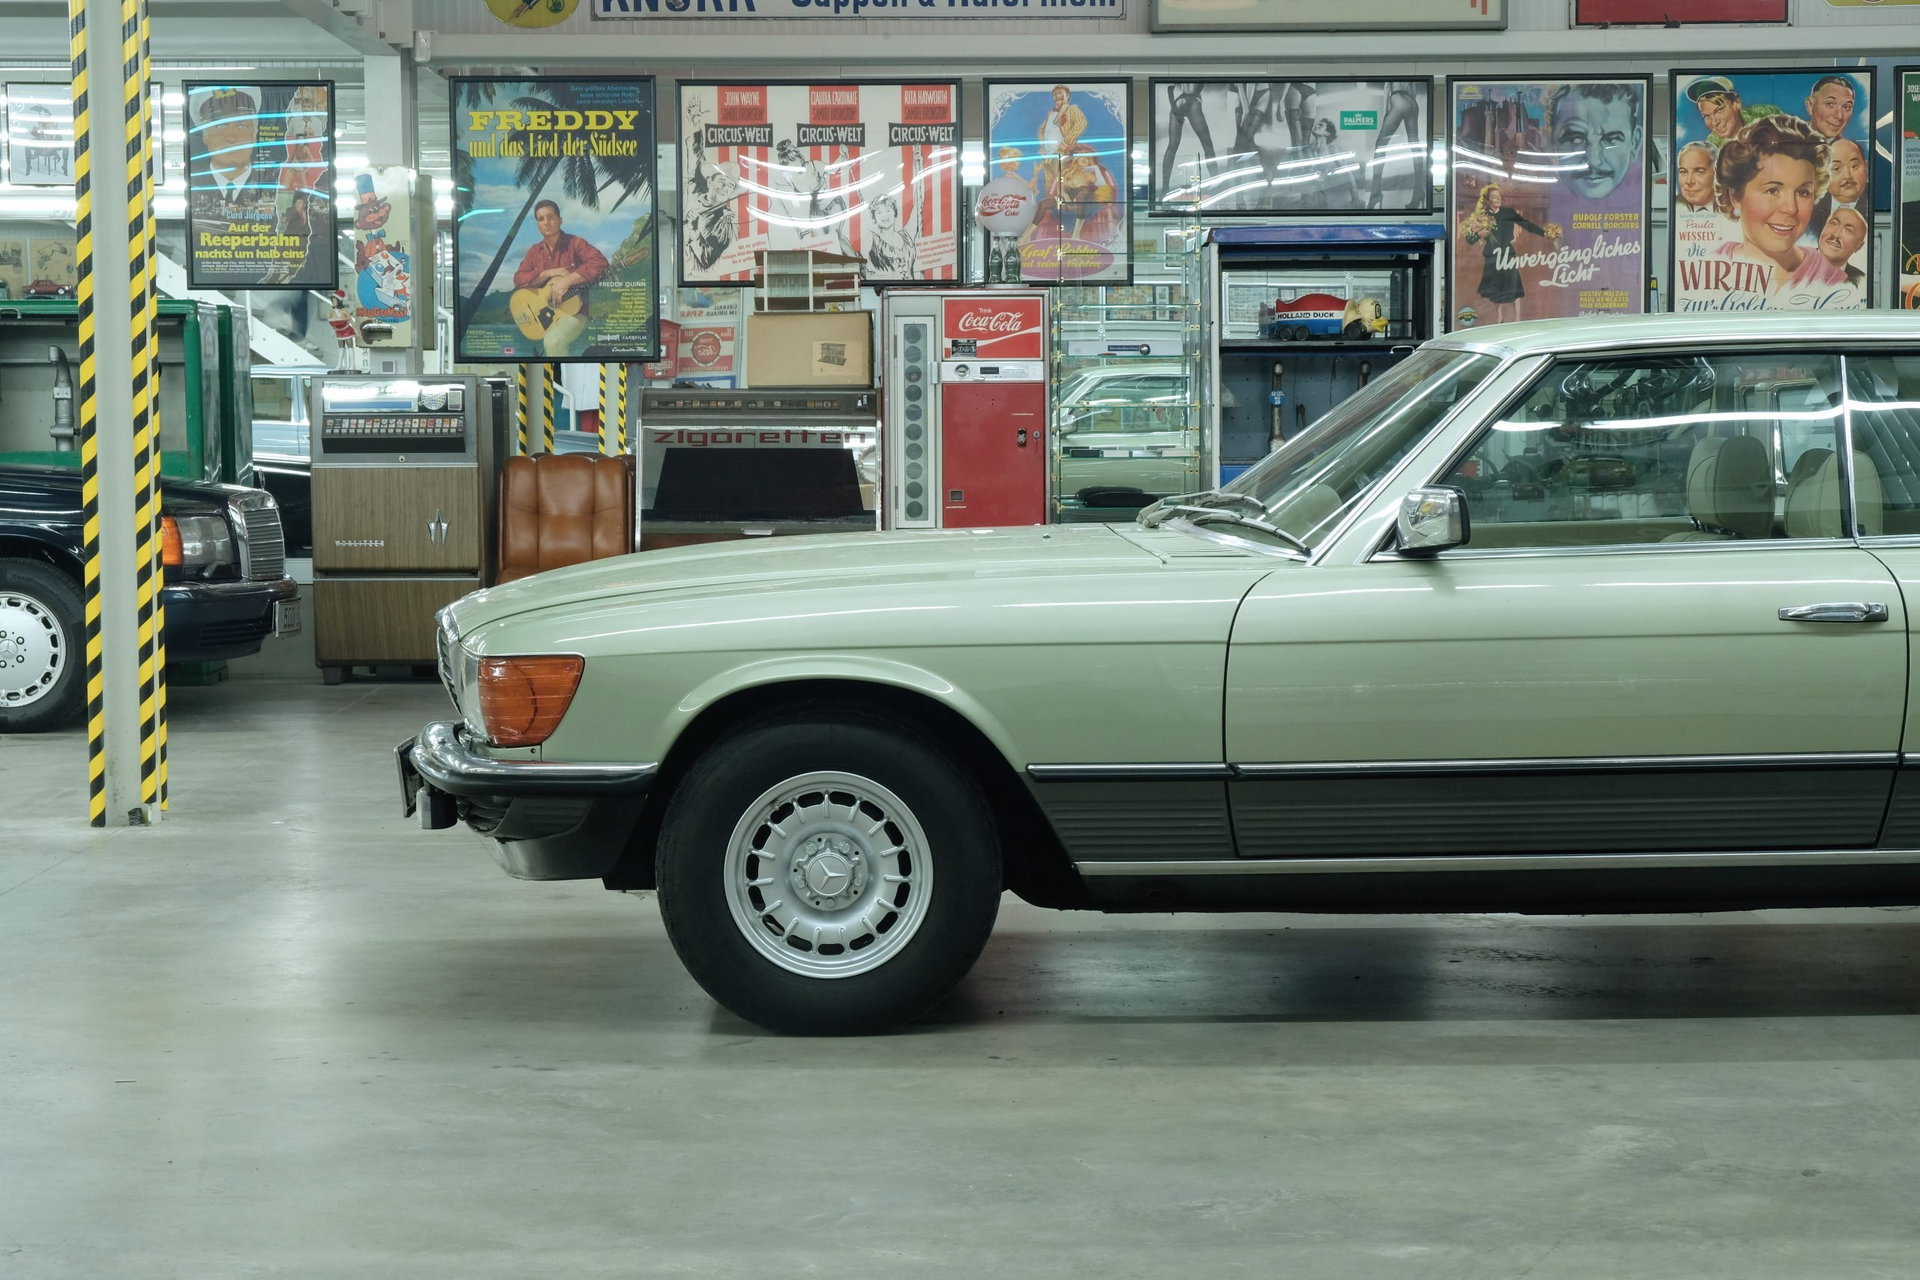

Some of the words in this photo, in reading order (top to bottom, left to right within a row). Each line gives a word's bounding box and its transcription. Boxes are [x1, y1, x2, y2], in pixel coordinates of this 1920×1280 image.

[724, 91, 740, 106] JOHN
[740, 91, 760, 106] WAYNE
[811, 91, 831, 106] CLAUDIA
[832, 91, 857, 106] CARDINALE
[904, 90, 917, 105] RITA
[918, 90, 948, 105] HAYWORTH
[468, 110, 638, 131] FREDDY
[469, 133, 496, 158] und
[500, 133, 524, 158] das
[529, 133, 559, 158] Lied
[563, 132, 587, 157] der
[590, 131, 638, 157] Südsee
[226, 211, 243, 219] Curd
[1005, 209, 1020, 217] Coke
[1573, 213, 1602, 221] RUDOLF
[1604, 213, 1640, 221] FORSTER
[228, 223, 249, 232] Auf
[252, 223, 271, 232] der
[1684, 219, 1714, 229] Paula
[200, 232, 300, 250] Reeperbahn
[1679, 231, 1716, 241] WESSELY
[195, 249, 233, 259] nachts
[235, 250, 254, 259] um
[256, 249, 280, 259] halb
[283, 249, 304, 259] eins
[1020, 244, 1053, 260] Graf
[1053, 241, 1099, 259] Bobby
[1493, 234, 1641, 271] Unvergängliches
[1539, 263, 1600, 288] Licht
[1678, 260, 1774, 296] WIRTIN
[958, 311, 1024, 332] Coca-Cola
[1277, 312, 1311, 320] HOLLAND
